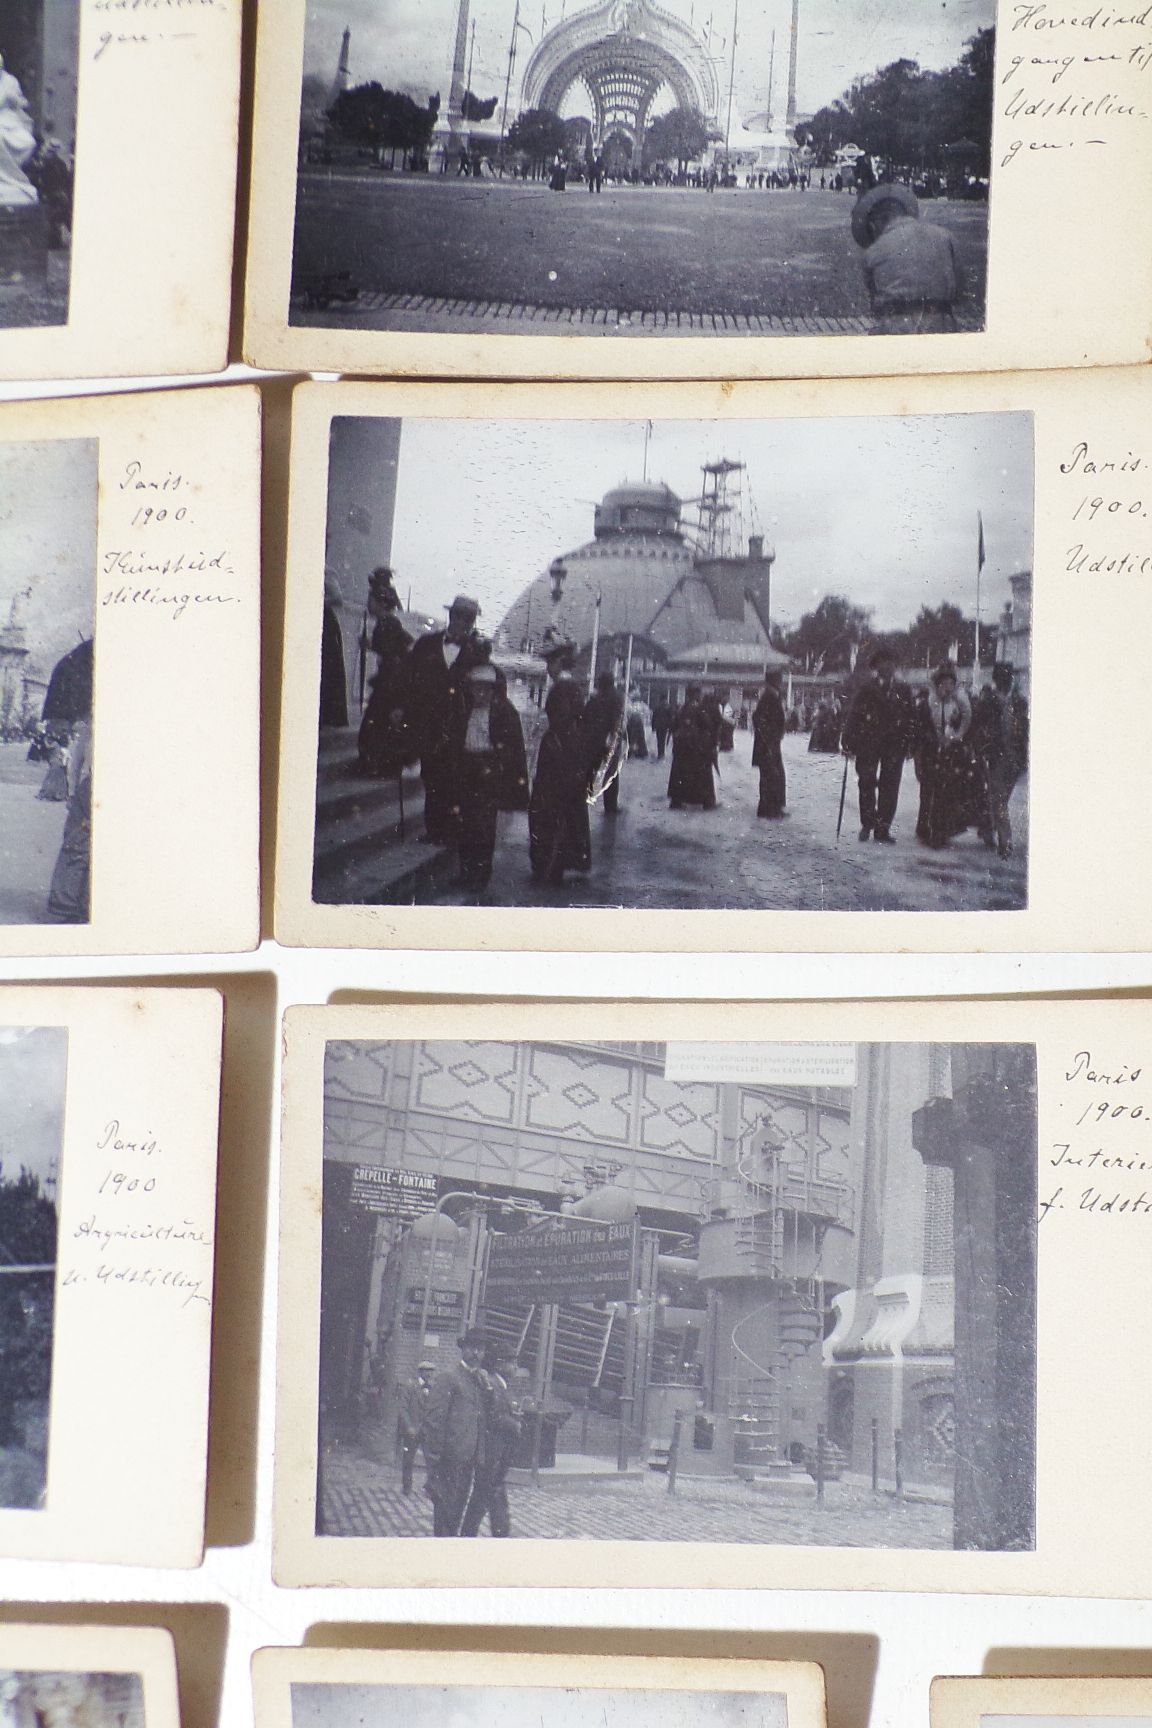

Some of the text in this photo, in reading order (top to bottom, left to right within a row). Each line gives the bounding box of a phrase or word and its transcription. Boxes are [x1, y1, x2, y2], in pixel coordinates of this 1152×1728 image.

[1060, 441, 1149, 474] Paris.
[119, 460, 189, 491] Paris.
[131, 507, 195, 526] 1900.
[1071, 496, 1148, 521] 1900.
[1066, 1051, 1142, 1084] Paris
[1076, 1102, 1151, 1126] 1900.
[98, 1170, 156, 1194] 1900
